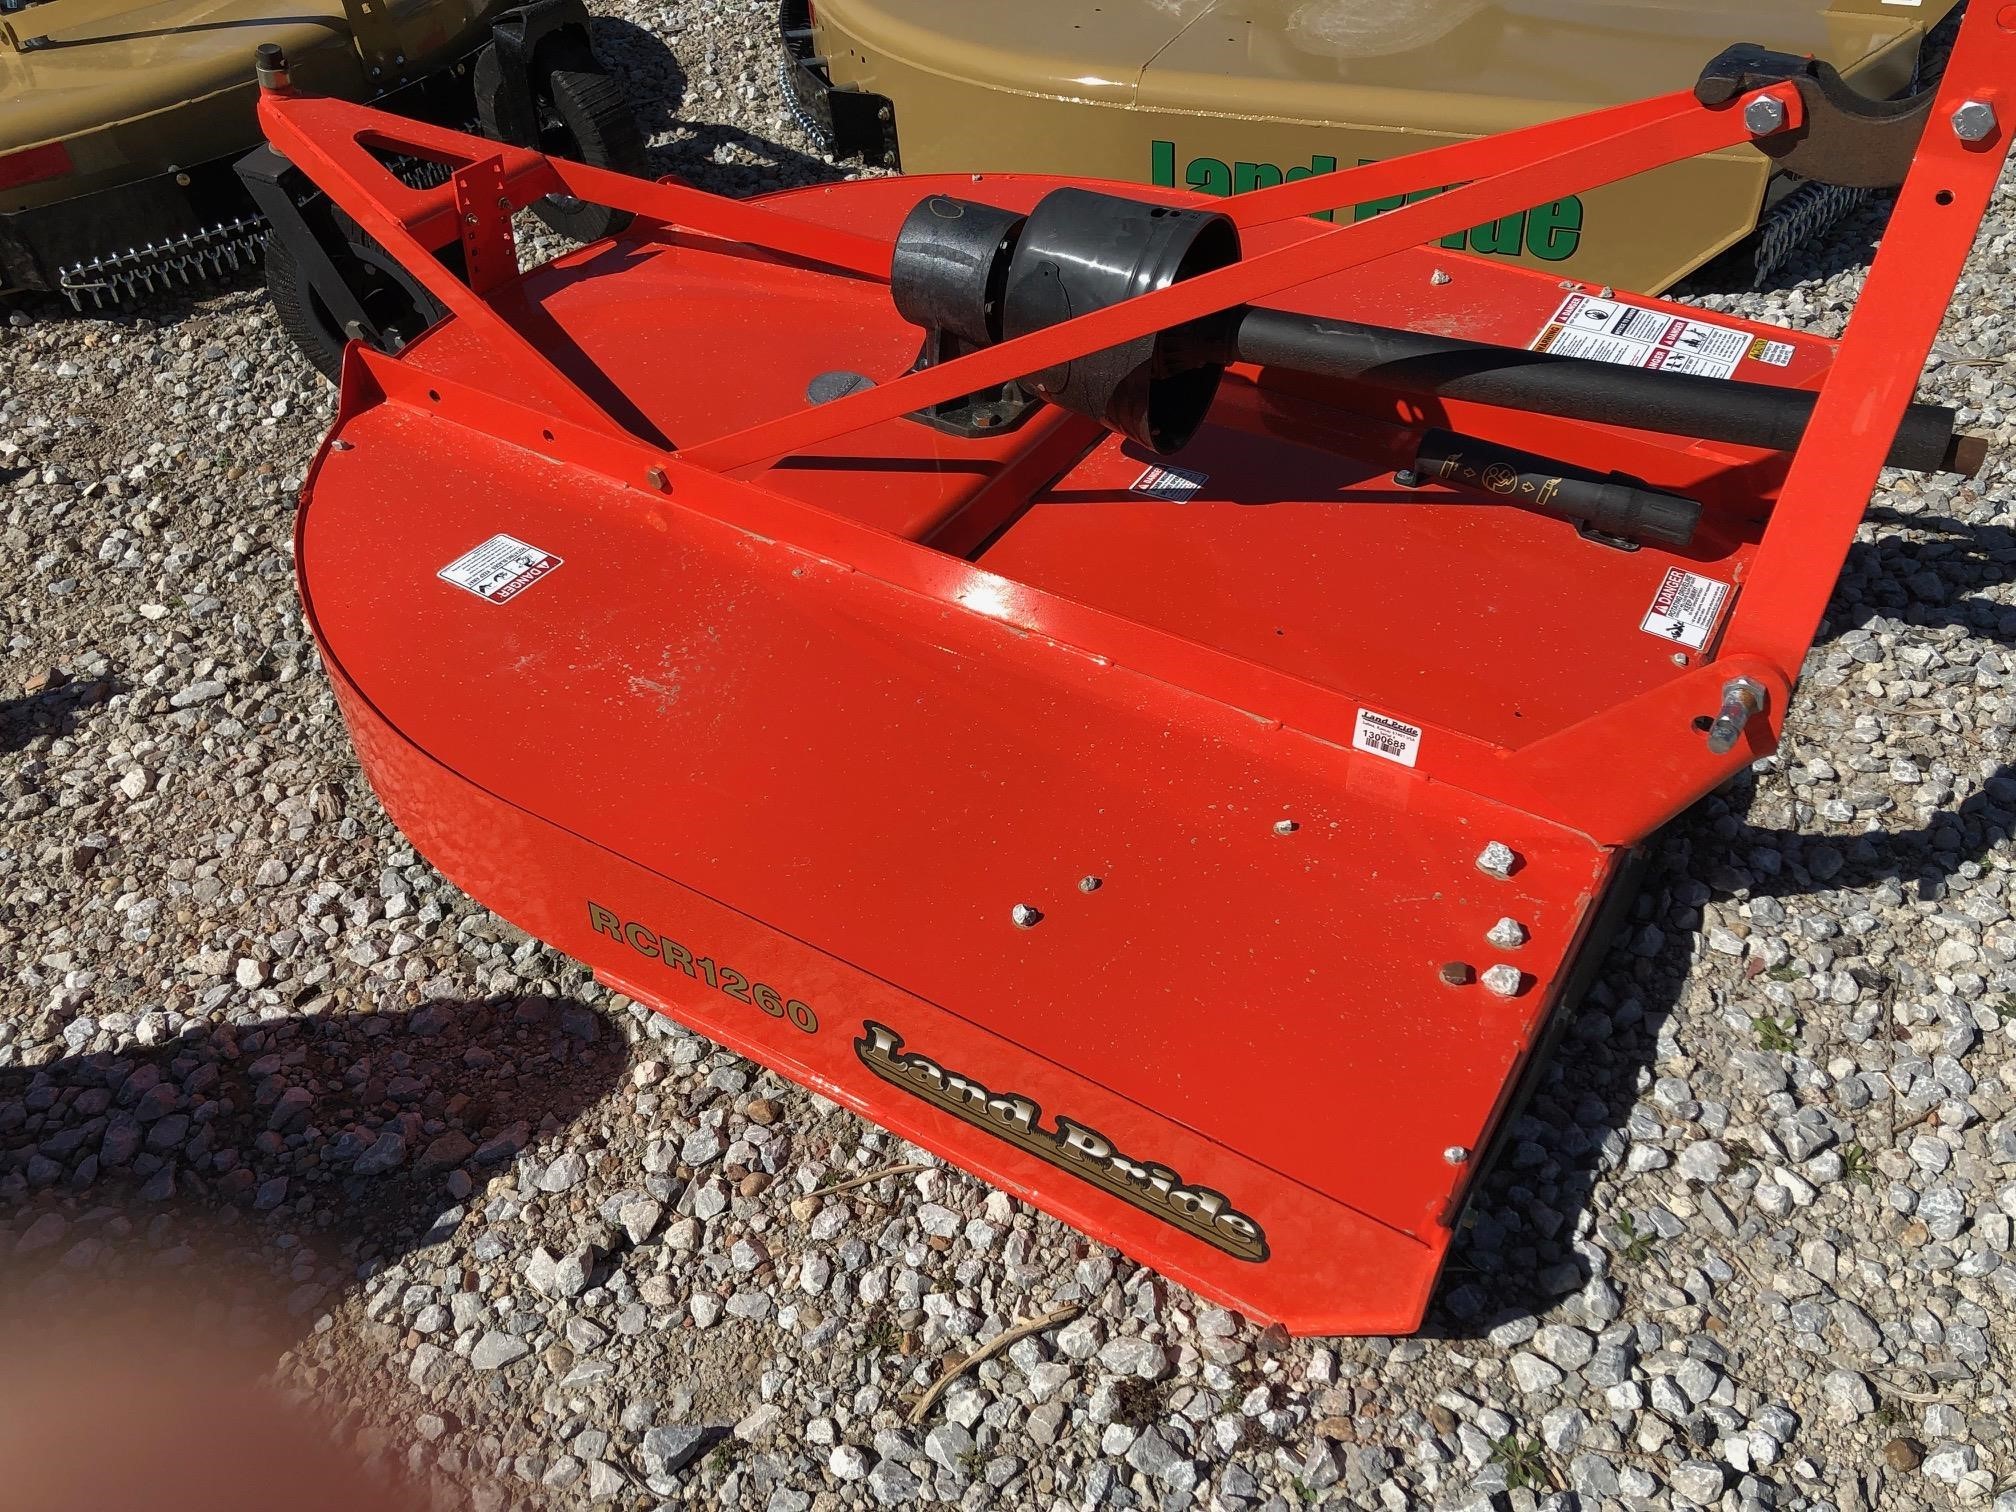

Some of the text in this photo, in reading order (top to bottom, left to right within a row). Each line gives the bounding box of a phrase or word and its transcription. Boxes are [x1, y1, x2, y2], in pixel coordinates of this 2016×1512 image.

[496, 566, 542, 598] DANGER
[1662, 570, 1685, 605] DANGER
[1361, 711, 1419, 737] Land Pride
[1363, 729, 1406, 750] 1300688
[588, 901, 819, 1034] RCR1260
[858, 1022, 1264, 1246] Land Pride
